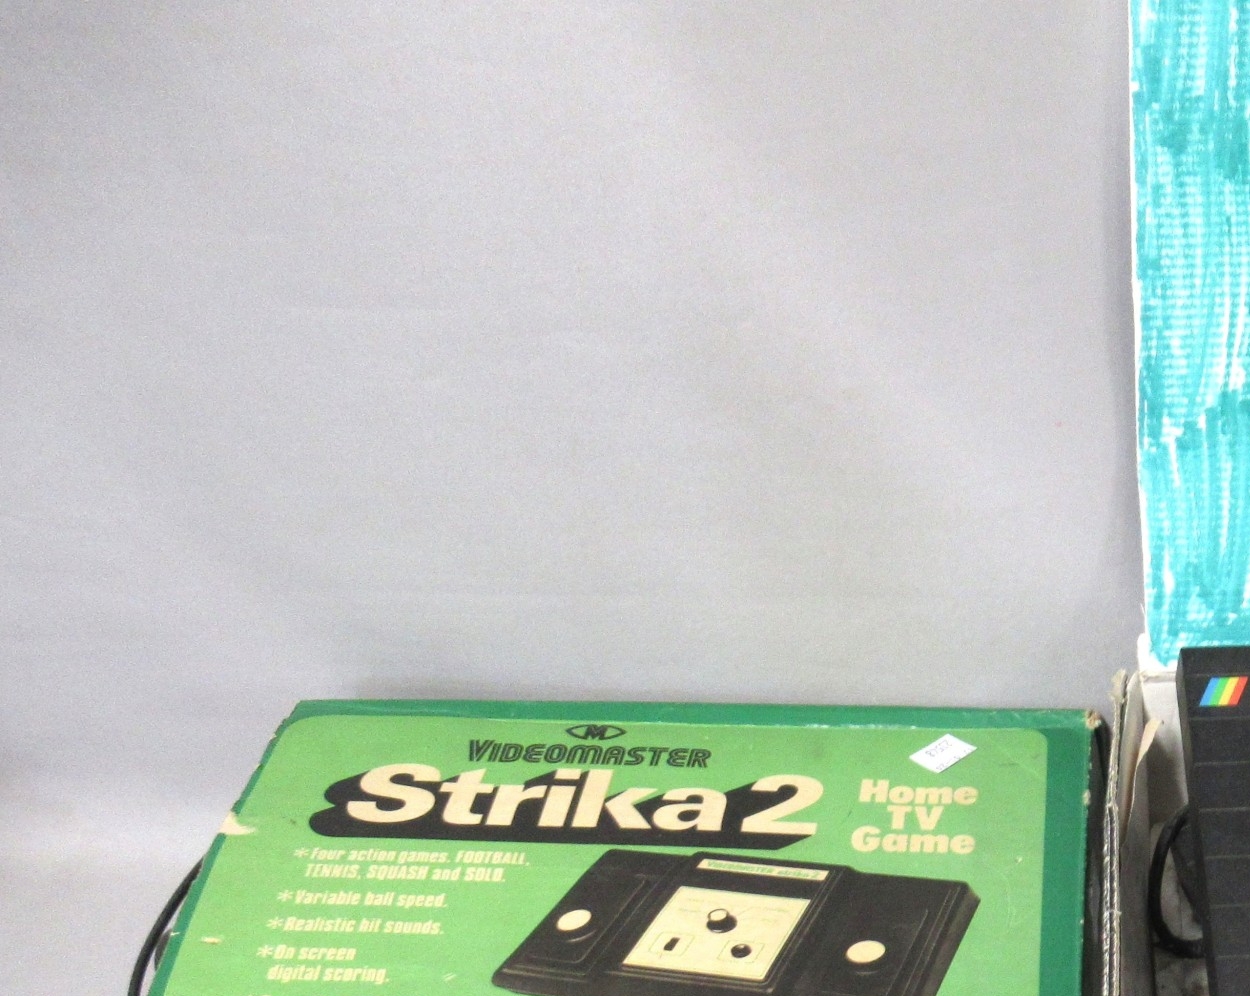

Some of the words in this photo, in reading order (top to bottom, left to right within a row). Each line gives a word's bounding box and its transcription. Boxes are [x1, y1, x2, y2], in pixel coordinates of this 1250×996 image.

[468, 739, 713, 768] VIDEOMASTER
[859, 779, 978, 804] Home
[887, 805, 944, 830] TV
[852, 826, 975, 854] Game
[366, 865, 428, 881] SQUASH
[432, 867, 460, 881] and
[294, 890, 361, 905] Variable
[365, 892, 394, 906] ball
[283, 917, 355, 933] Realistic
[359, 919, 381, 933] hit
[298, 947, 356, 960] screen
[267, 965, 320, 982] digital
